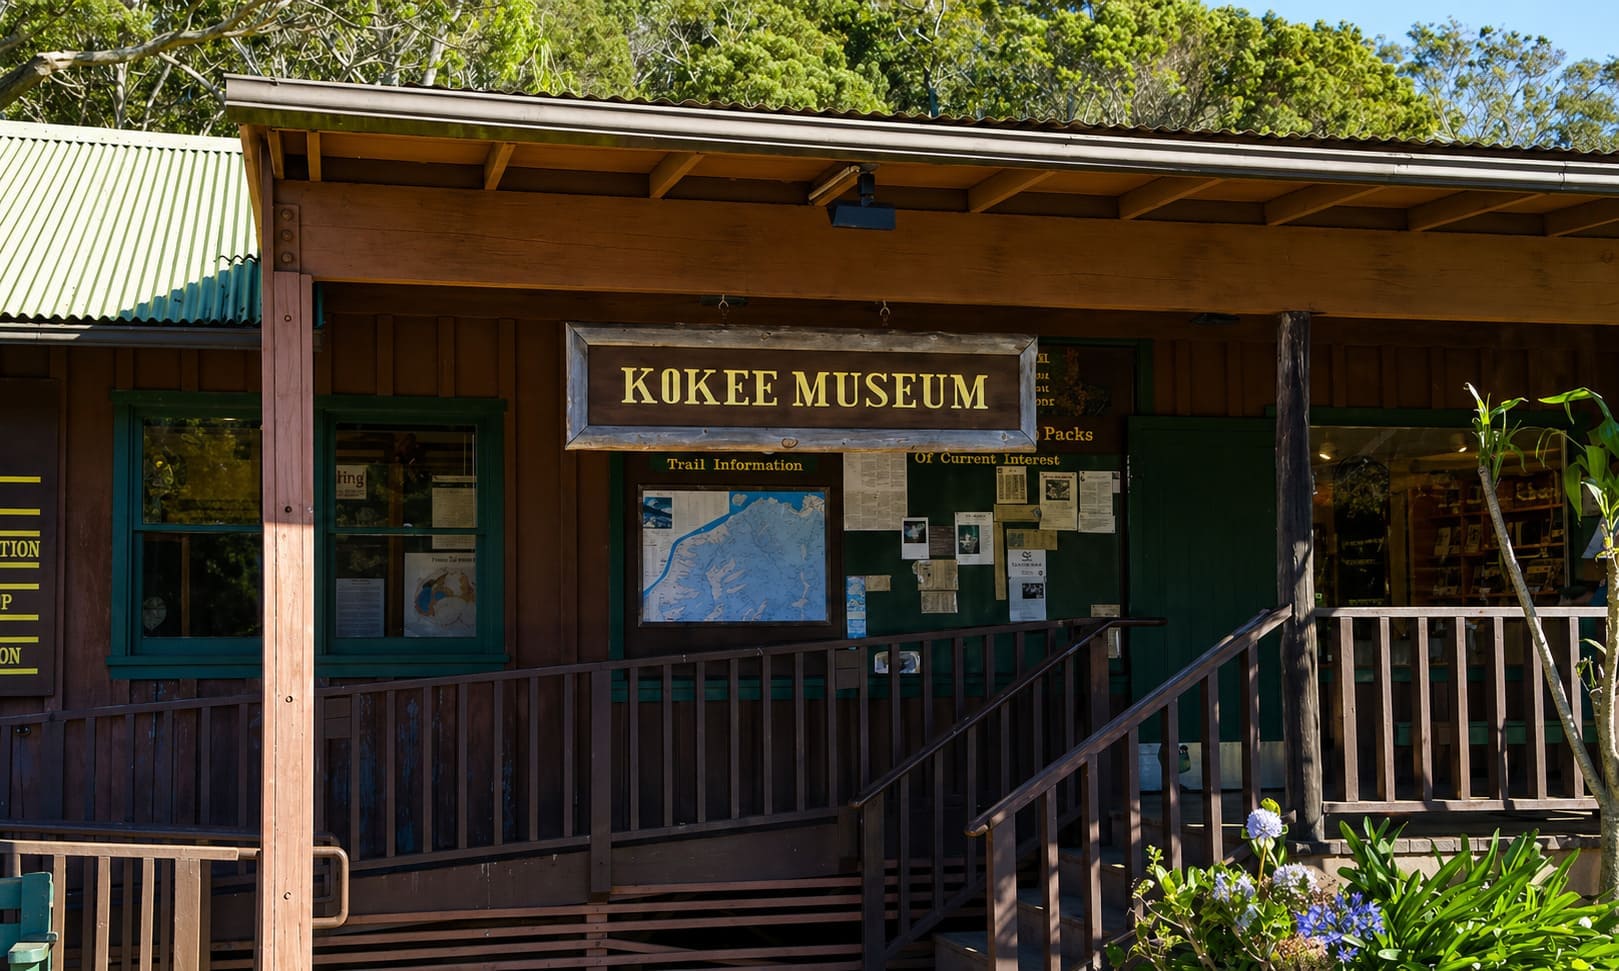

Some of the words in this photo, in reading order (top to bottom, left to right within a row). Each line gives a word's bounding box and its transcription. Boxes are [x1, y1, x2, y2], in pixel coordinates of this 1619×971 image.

[620, 367, 778, 407] KOKEE
[791, 371, 989, 410] MUSEUM
[1044, 426, 1094, 441] Packs
[667, 458, 705, 470] Trail
[713, 458, 803, 471] Information
[914, 452, 933, 464] Of
[940, 452, 996, 465] Current
[1004, 453, 1060, 466] Interest
